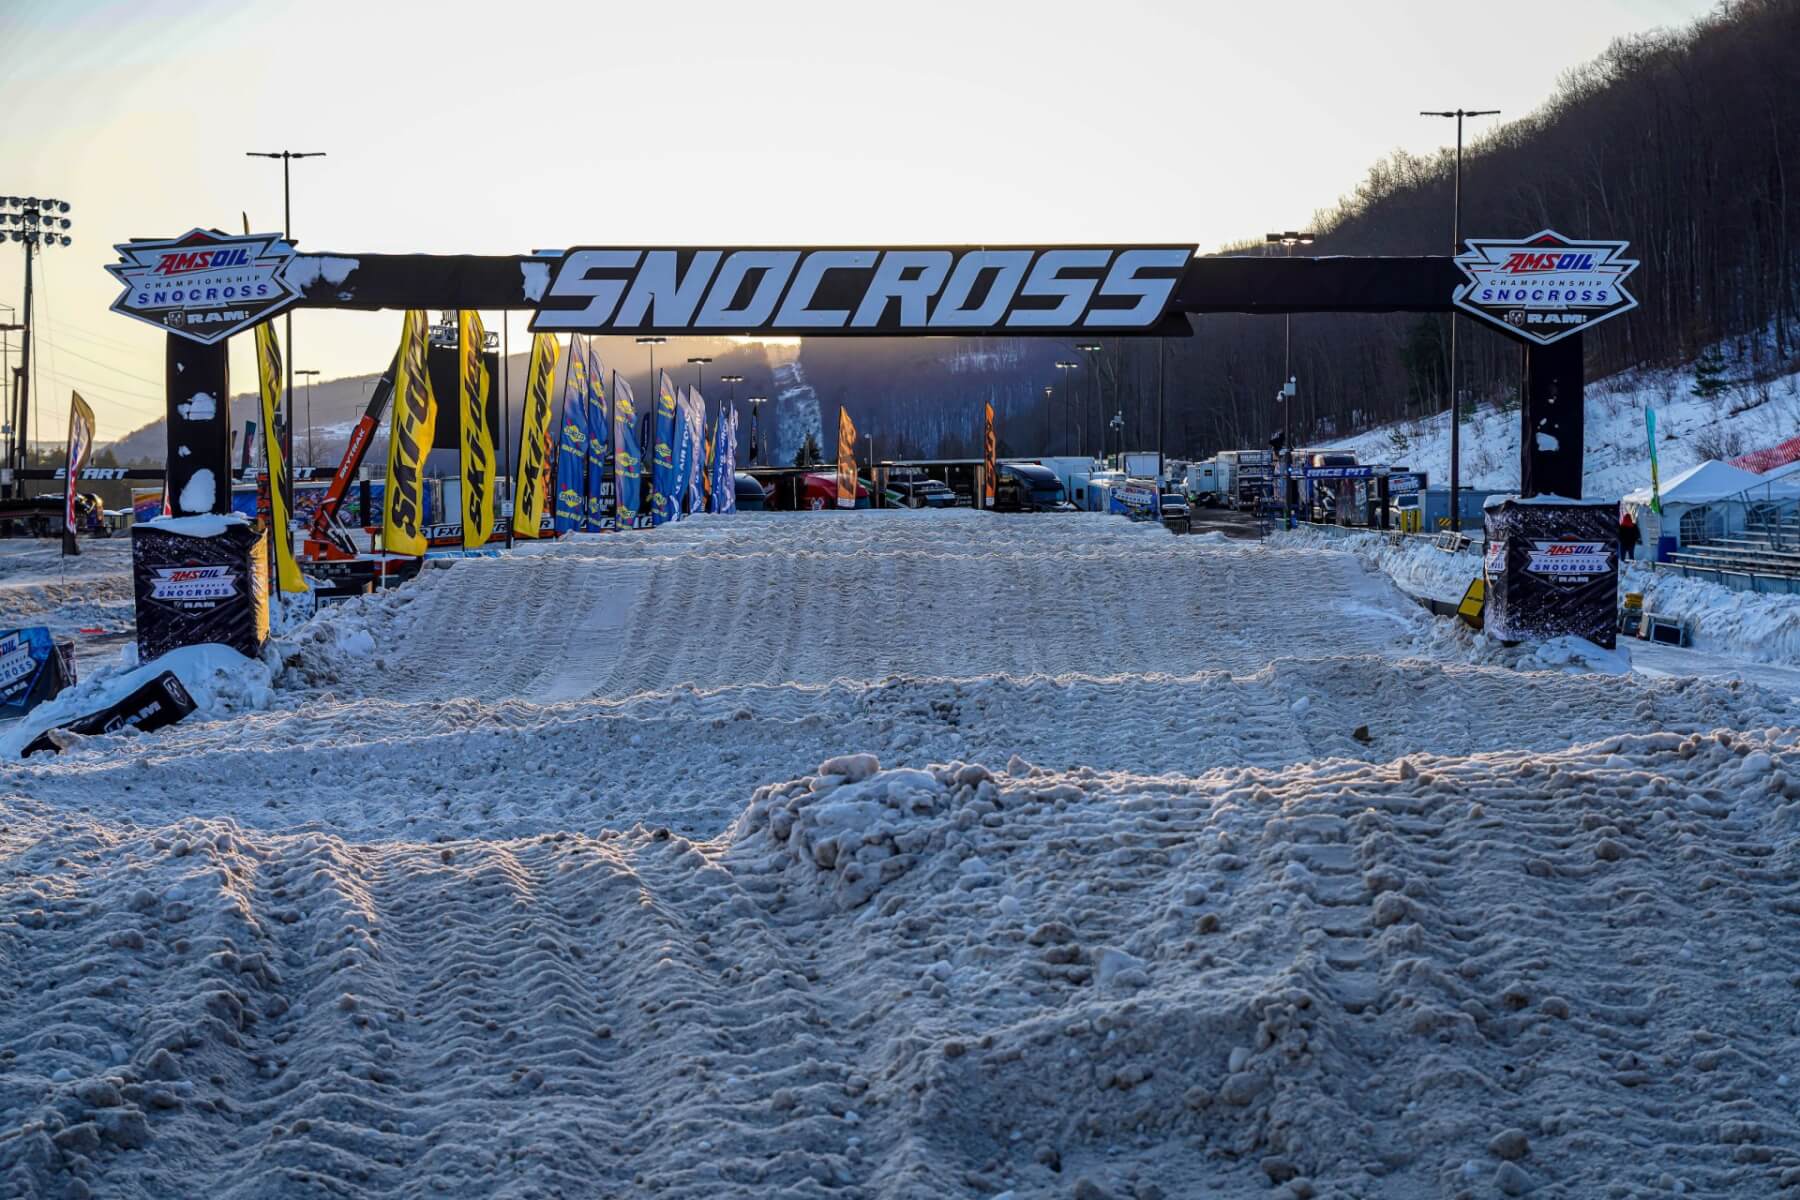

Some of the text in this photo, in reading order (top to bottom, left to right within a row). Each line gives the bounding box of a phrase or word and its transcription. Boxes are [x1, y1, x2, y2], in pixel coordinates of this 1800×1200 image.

[153, 249, 250, 276] AMSOIL
[1501, 252, 1593, 274] AMSOIL
[144, 275, 261, 289] CHAMPIONSHIP
[532, 249, 1188, 327] SNOCROSS
[138, 284, 268, 304] SNOCROSS
[1482, 289, 1609, 301] SNOCROSS
[187, 310, 244, 324] RAM
[1527, 313, 1583, 324] RAM
[340, 428, 365, 479] SKYTRAK
[53, 467, 129, 480] SART
[1545, 545, 1595, 556] AMSOIL
[170, 569, 219, 582] AMSOIL
[158, 588, 229, 597] SNOCROSS
